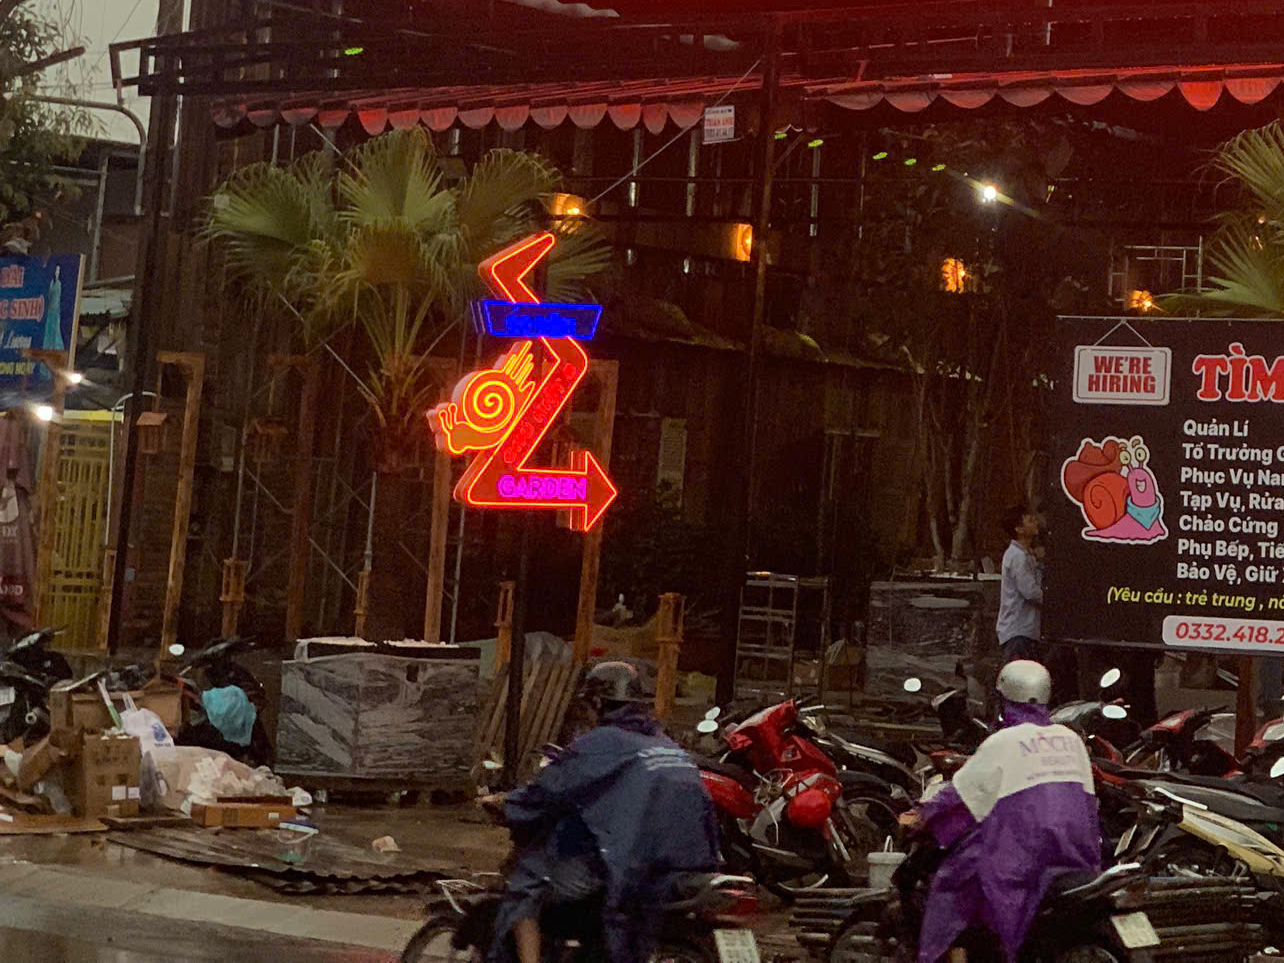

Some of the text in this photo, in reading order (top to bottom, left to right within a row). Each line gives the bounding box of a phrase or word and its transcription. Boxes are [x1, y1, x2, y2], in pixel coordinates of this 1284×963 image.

[1094, 356, 1152, 374] WE'RE
[1088, 374, 1156, 393] HIRING
[1183, 418, 1230, 437] Quản
[1233, 419, 1249, 437] Lí
[1207, 442, 1273, 465] Trưởng
[498, 475, 587, 501] GARDEN
[1180, 466, 1225, 487] Phục
[1229, 468, 1253, 488] Vụ
[1180, 491, 1212, 511] Tạp
[1216, 492, 1245, 513] Vụ,
[1249, 491, 1284, 510] Rửa
[1179, 514, 1224, 532] Chảo
[1228, 516, 1278, 537] Cứng
[1177, 539, 1211, 560] Phụ
[1215, 540, 1253, 560] Bếp,
[1177, 562, 1210, 580] Bảo
[1213, 564, 1242, 585] Vệ,
[1245, 565, 1279, 583] Giữ
[1107, 587, 1140, 604] (Yêu
[1185, 589, 1207, 605] trẻ
[1212, 592, 1256, 611] trung
